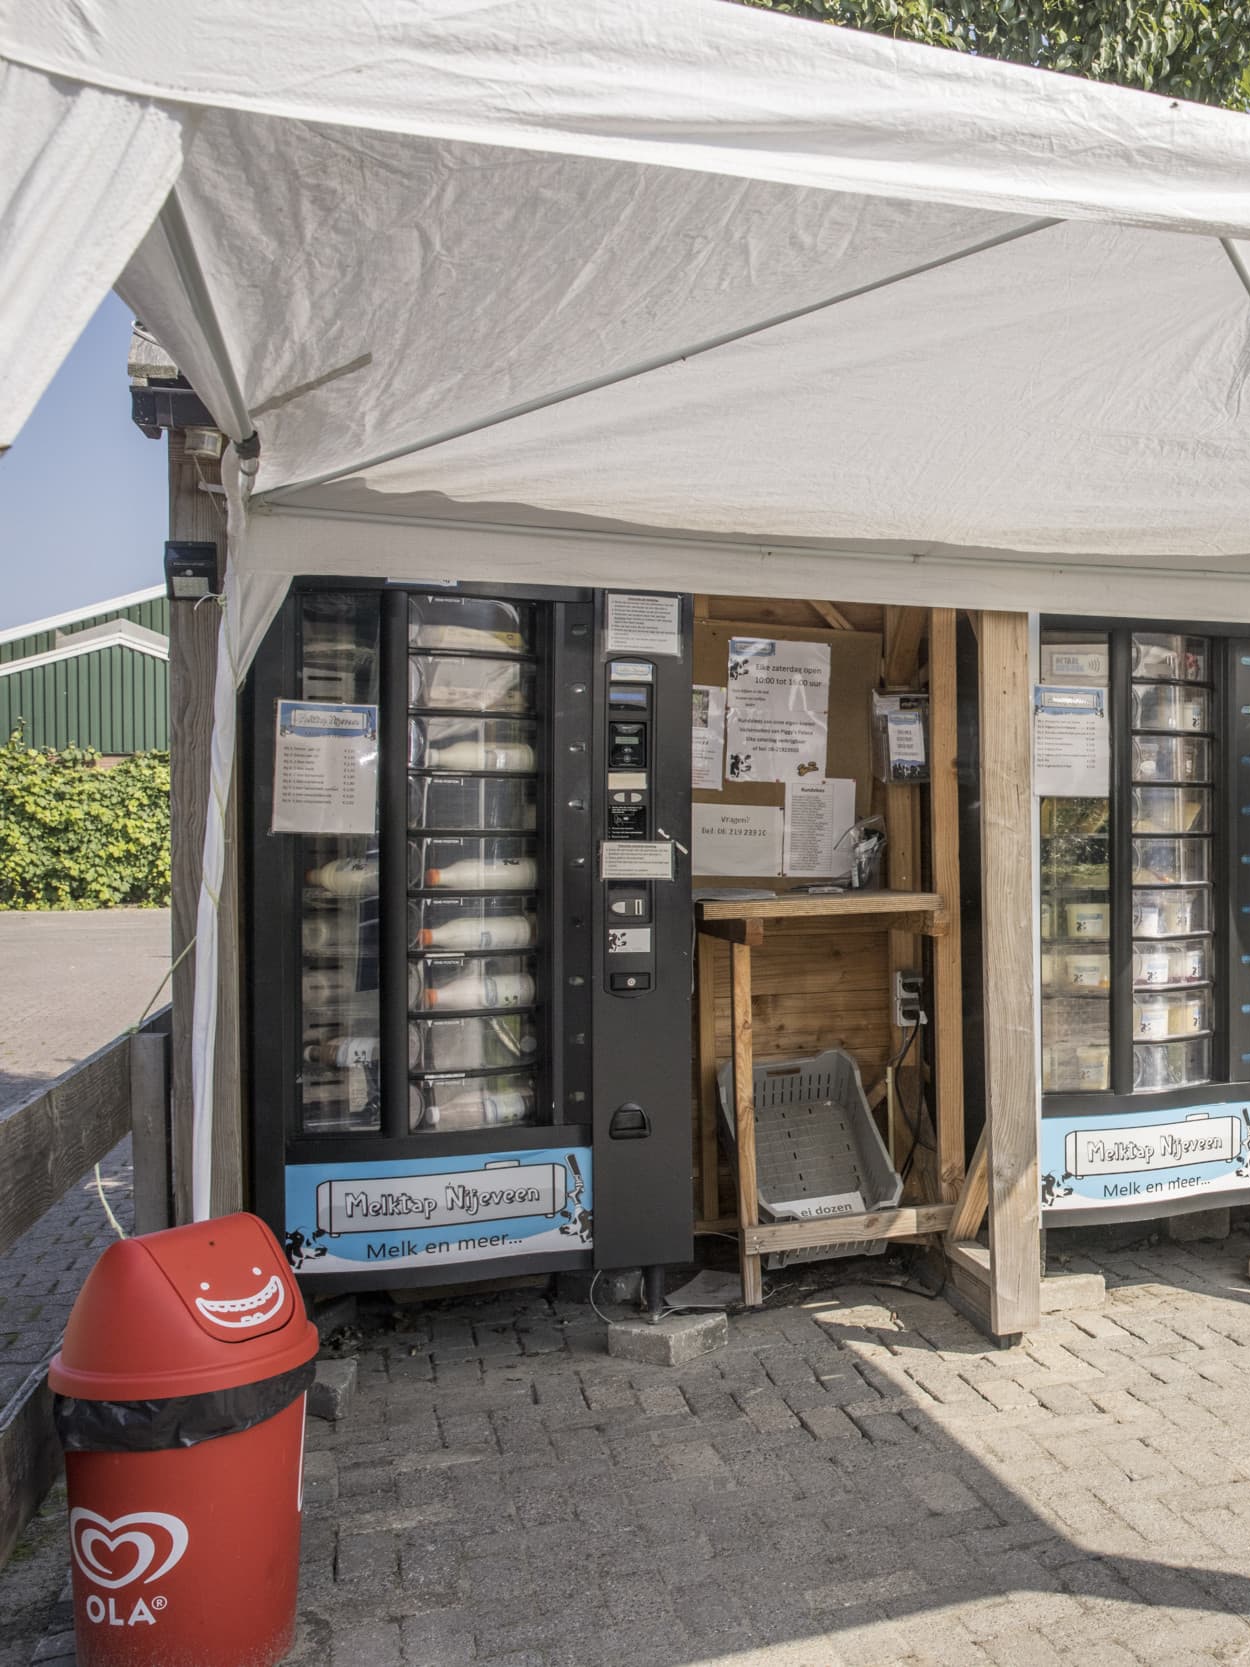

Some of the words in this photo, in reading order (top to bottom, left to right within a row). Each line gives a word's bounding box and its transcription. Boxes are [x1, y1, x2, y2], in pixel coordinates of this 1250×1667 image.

[755, 663, 771, 672] Elke
[772, 665, 802, 674] zaterdag
[803, 667, 822, 675] open
[776, 678, 787, 686] tot
[1087, 1139, 1155, 1164] Melktap
[1159, 1134, 1223, 1160] Nijeveen
[1103, 1182, 1141, 1198] Melk
[1146, 1182, 1163, 1193] en
[345, 1191, 437, 1219] Melktap
[444, 1185, 540, 1215] Nijeveen
[815, 1203, 853, 1215] dozen
[366, 1239, 418, 1259] Melk
[425, 1239, 450, 1254] en
[457, 1232, 523, 1251] meer...
